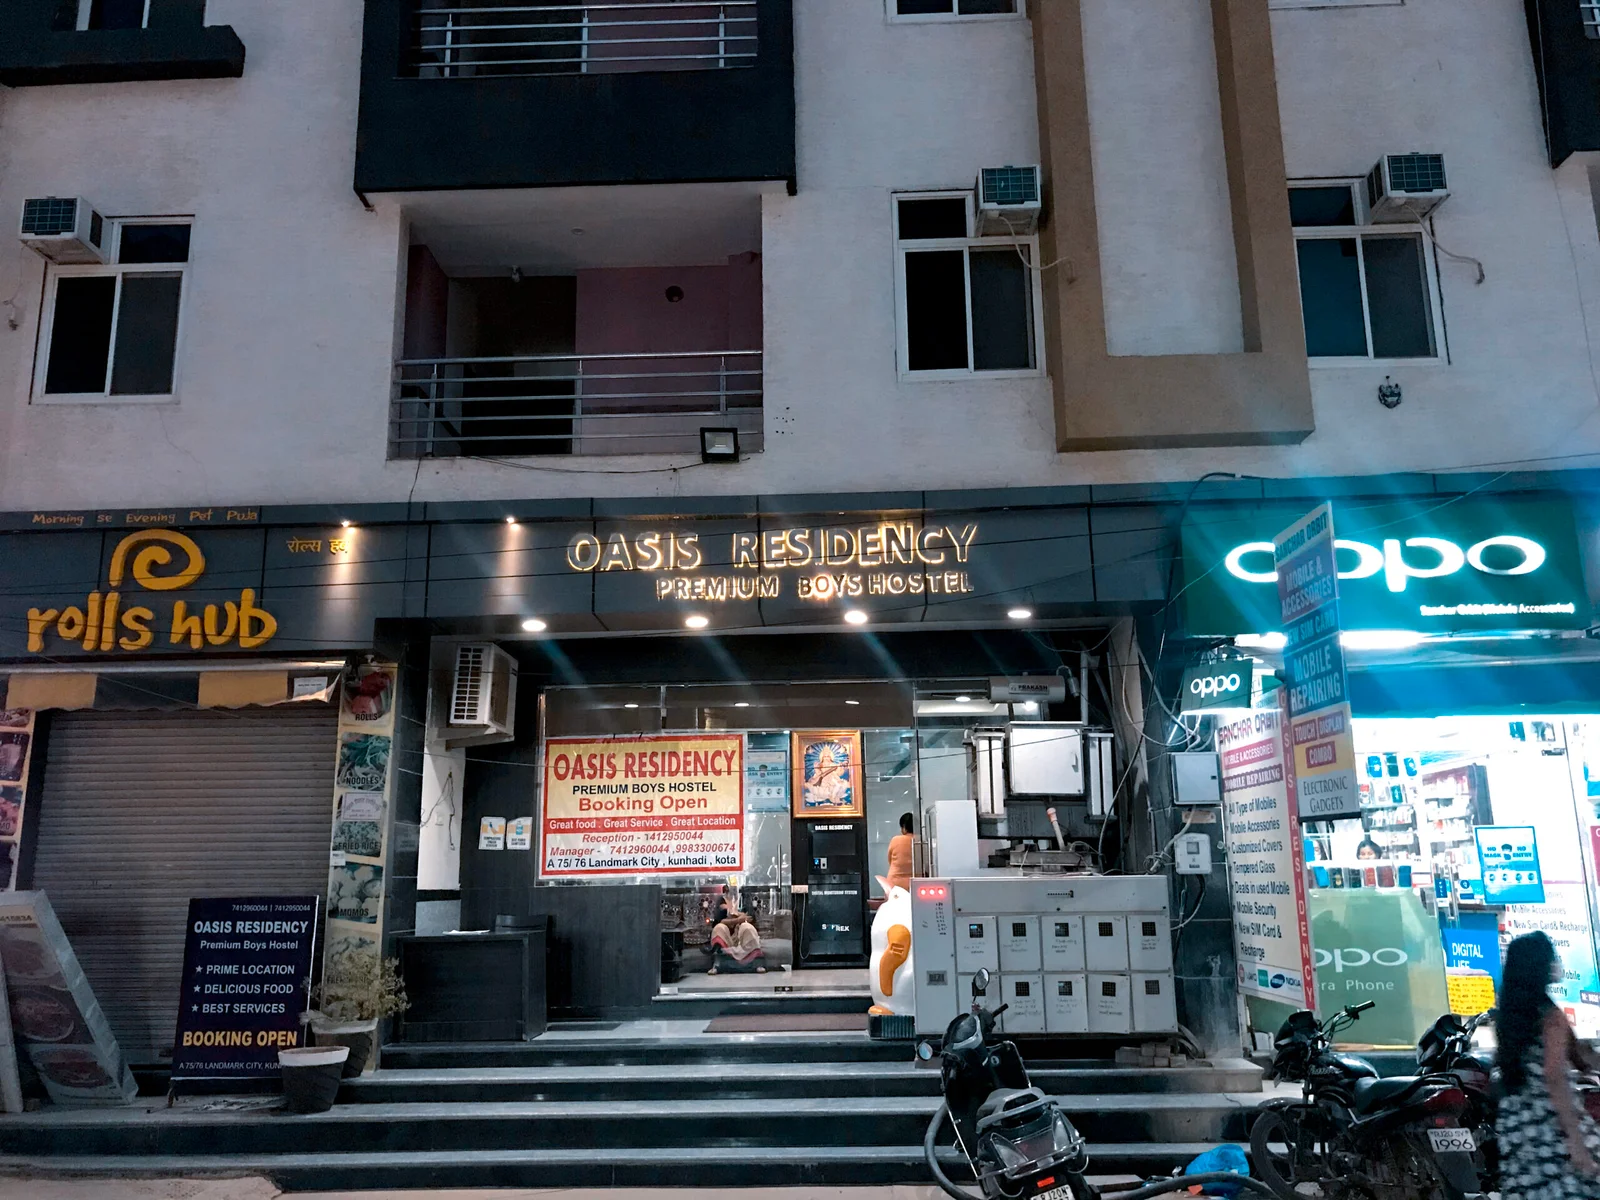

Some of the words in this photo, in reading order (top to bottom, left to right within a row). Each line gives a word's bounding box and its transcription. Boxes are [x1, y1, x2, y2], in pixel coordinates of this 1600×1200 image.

[32, 514, 84, 526] Morning
[126, 512, 176, 524] Evening
[189, 509, 213, 522] Pet
[226, 510, 258, 521] Puja
[1307, 512, 1328, 540] ORBIT
[286, 536, 322, 553] रोल्स
[566, 531, 702, 572] OASIS
[733, 523, 978, 569] RESIDENCY
[1286, 560, 1314, 593] MOBILE
[1315, 556, 1323, 576] &
[656, 575, 780, 601] PREMIUM
[798, 573, 863, 600] BOYS
[868, 570, 975, 596] HOSTEL
[1282, 575, 1332, 618] ACCESSORIES
[27, 590, 154, 653] rolls
[169, 588, 278, 650] hub
[1301, 620, 1314, 640] SIM
[1315, 609, 1335, 633] CARD
[1293, 644, 1332, 682] MOBILE
[1290, 674, 1341, 712] REPAIRING
[355, 712, 378, 721] ROLLS
[1219, 717, 1252, 746] SANCHAR
[1254, 711, 1279, 733] ORBIT
[1294, 721, 1317, 742] TOUCH
[1224, 751, 1239, 765] MOBILE
[1309, 745, 1333, 765] COMBO
[553, 752, 617, 781] OASIS
[624, 749, 736, 779] RESIDENCY
[346, 776, 379, 785] NOODLES
[1224, 776, 1246, 789] MOBILE
[1246, 768, 1280, 785] REPAIRING
[1303, 776, 1348, 796] ELECTRONIC
[572, 784, 629, 795] PREMIUM
[632, 783, 665, 793] BOYS
[669, 782, 717, 792] HOSTEL
[579, 797, 654, 812] Booking
[660, 796, 708, 811] Open
[1236, 801, 1247, 816] Type
[1248, 799, 1254, 811] of
[1254, 796, 1277, 811] Mobiles
[1309, 796, 1343, 813] GADGETS
[550, 819, 574, 830] Great
[575, 819, 596, 829] food
[603, 818, 628, 829] Great
[630, 817, 663, 828] Service
[671, 816, 696, 827] Great
[697, 815, 736, 826] Location
[1230, 821, 1246, 835] Mobile
[1247, 817, 1280, 833] Accessories
[338, 842, 360, 850] FRIED
[361, 841, 378, 849] RICE
[582, 834, 634, 844] Reception
[1231, 840, 1260, 854] Customized
[1262, 839, 1283, 851] Covers
[550, 847, 595, 857] Manager
[610, 845, 669, 855] 7412960044
[547, 859, 555, 868] A
[575, 857, 587, 867] 76
[588, 856, 638, 867] Landmark
[640, 856, 660, 868] City
[668, 855, 707, 865] kunhadi
[715, 855, 736, 864] kota
[1233, 862, 1258, 878] Tempered
[1260, 862, 1276, 873] Glass
[1234, 882, 1250, 895] Deals
[1250, 883, 1256, 894] in
[1256, 882, 1270, 895] used
[1270, 881, 1290, 895] Mobile
[339, 908, 369, 917] MOMOS
[1236, 902, 1253, 914] Mobile
[1254, 904, 1276, 919] Security
[194, 921, 232, 934] OASIS
[236, 920, 308, 934] RESIDENCY
[1238, 922, 1250, 935] New
[1250, 923, 1261, 936] SIM
[1261, 924, 1276, 938] Card
[1277, 927, 1282, 938] &
[1513, 920, 1526, 929] New
[1528, 920, 1538, 929] Sim
[1560, 921, 1588, 934] Recharge
[200, 940, 241, 949] Premium
[243, 940, 267, 951] Boys
[269, 940, 299, 949] Hostel
[1240, 942, 1265, 961] Recharge
[1452, 943, 1484, 958] DIGITAL
[206, 965, 239, 974] PRIME
[241, 964, 295, 974] LOCATION
[204, 984, 261, 994] DELICIOUS
[263, 984, 294, 994] FOOD
[1346, 979, 1395, 991] Phone
[202, 1004, 230, 1013] BEST
[232, 1003, 286, 1014] SERVICES
[182, 1031, 253, 1046] BOOKING
[256, 1031, 298, 1046] OPEN
[1434, 1139, 1473, 1150] 1996
